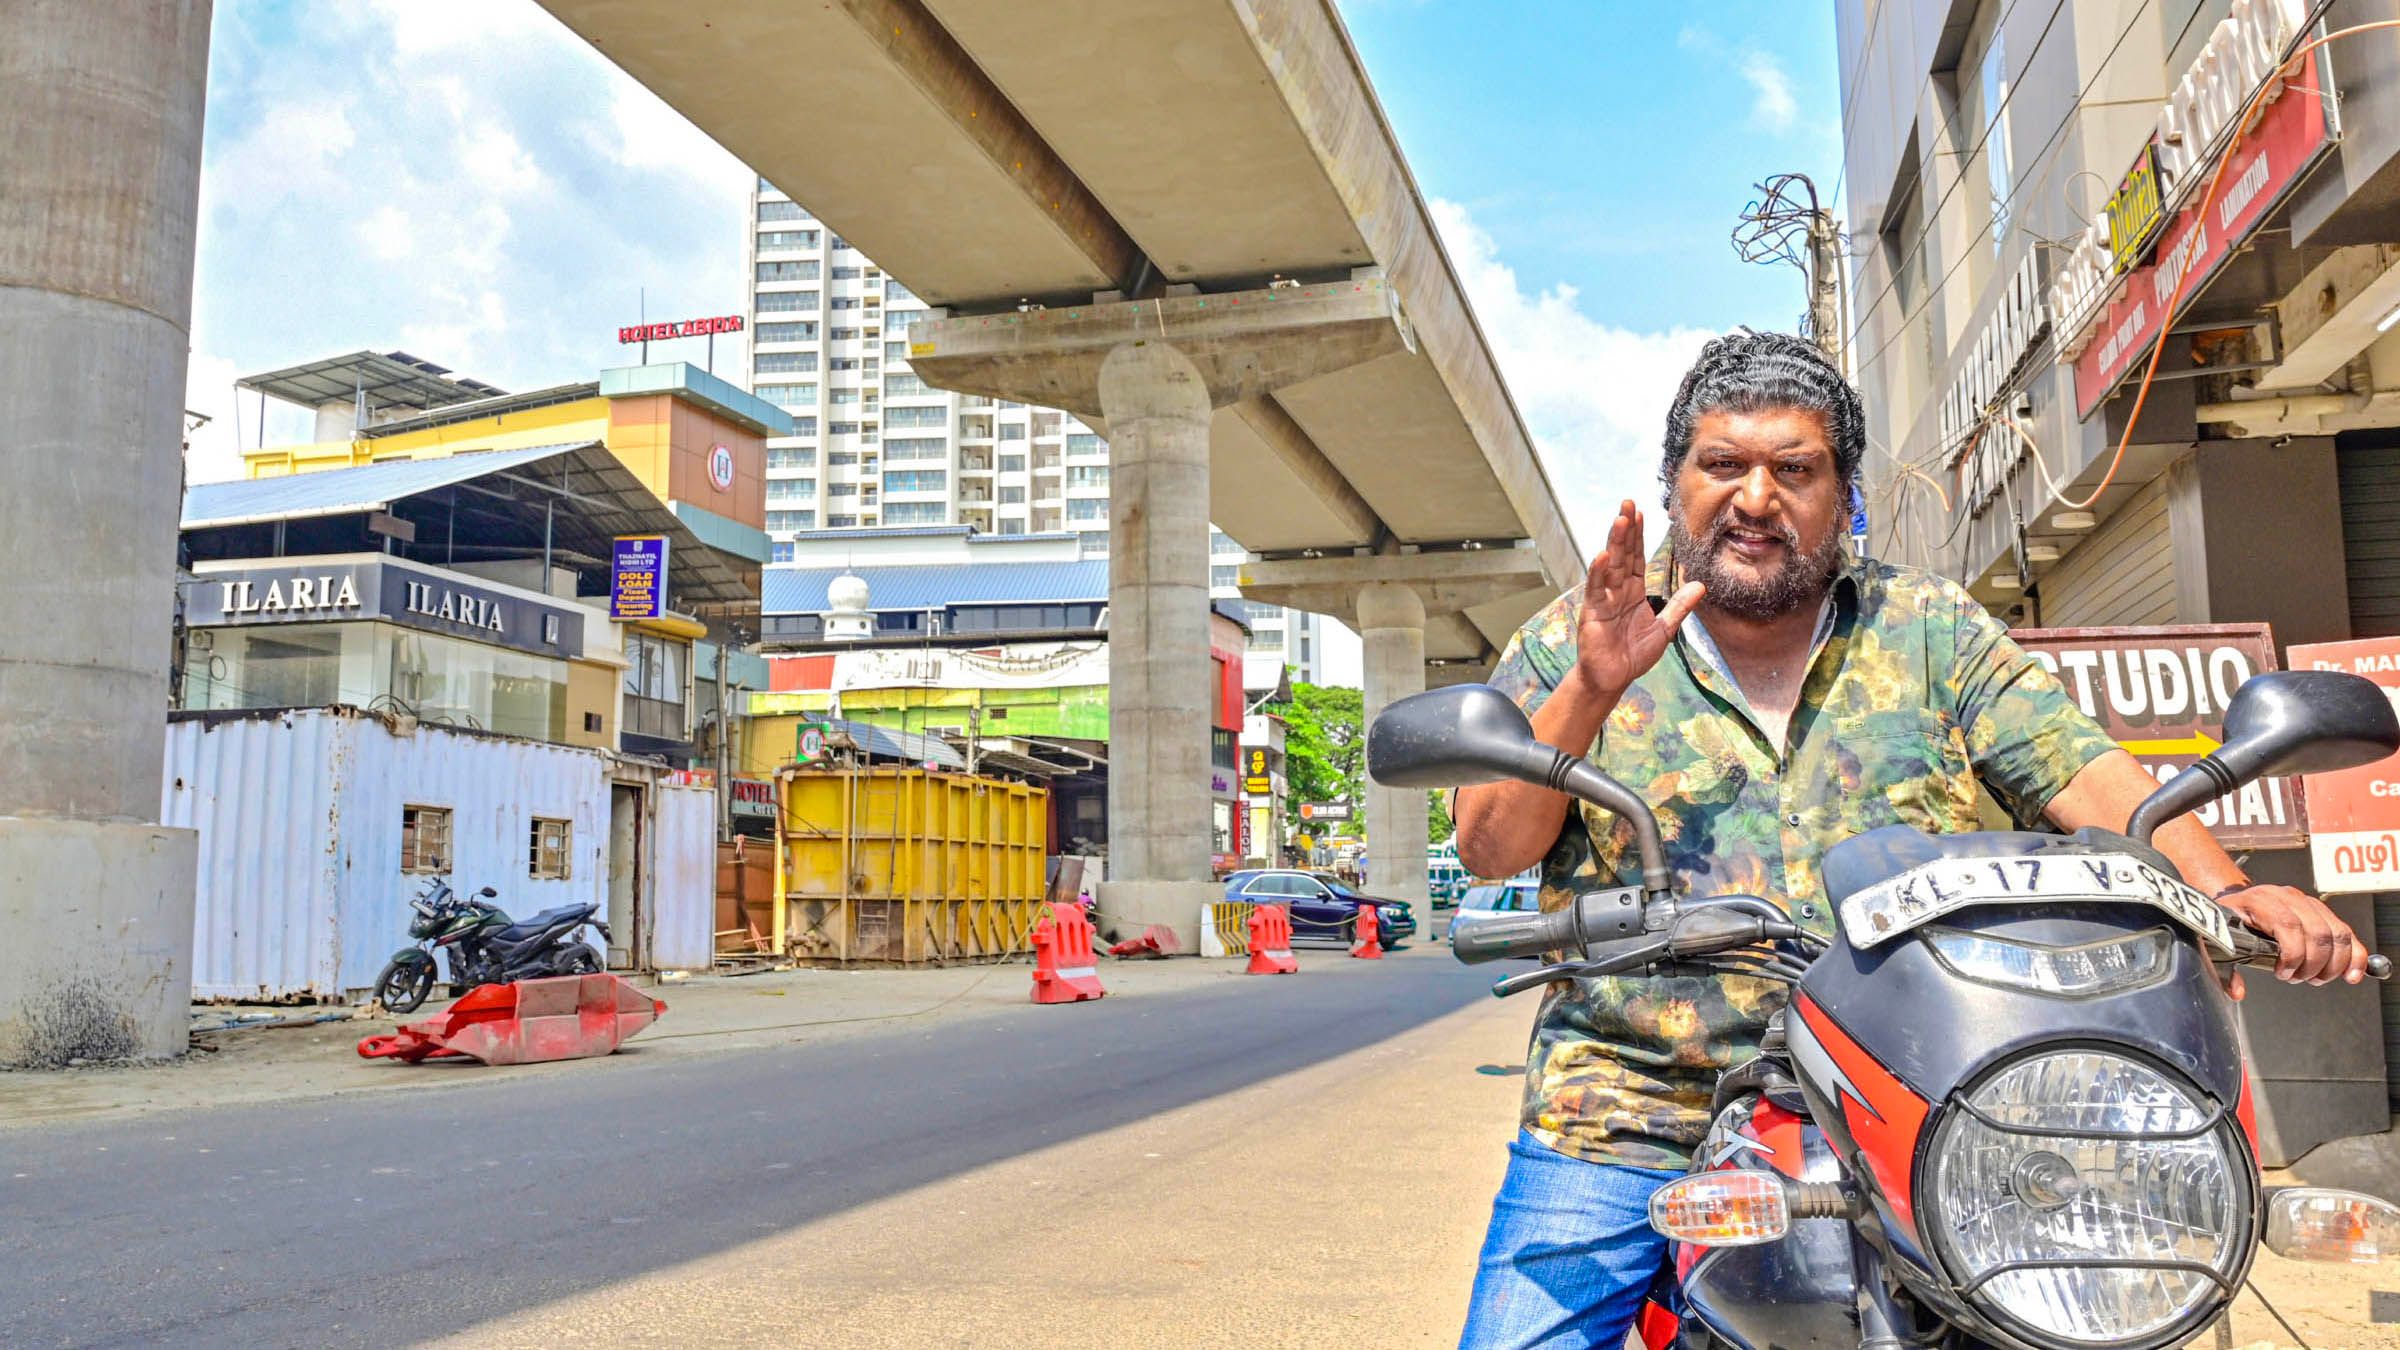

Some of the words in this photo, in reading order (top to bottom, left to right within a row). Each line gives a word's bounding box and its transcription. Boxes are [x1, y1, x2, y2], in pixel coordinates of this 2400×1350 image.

[2220, 149, 2269, 231] LAMINATION
[618, 322, 678, 344] HOTEL
[681, 315, 743, 337] ABIDA
[220, 575, 360, 614] ILARIA
[618, 572, 653, 580] GOLD
[407, 581, 504, 633] ILARIA
[734, 782, 772, 804] HOTEL
[1241, 809, 1250, 854] SALON
[1896, 874, 1961, 907] KL
[1988, 859, 2041, 891] 17
[2082, 859, 2111, 890] V
[2137, 865, 2219, 937] 9357
